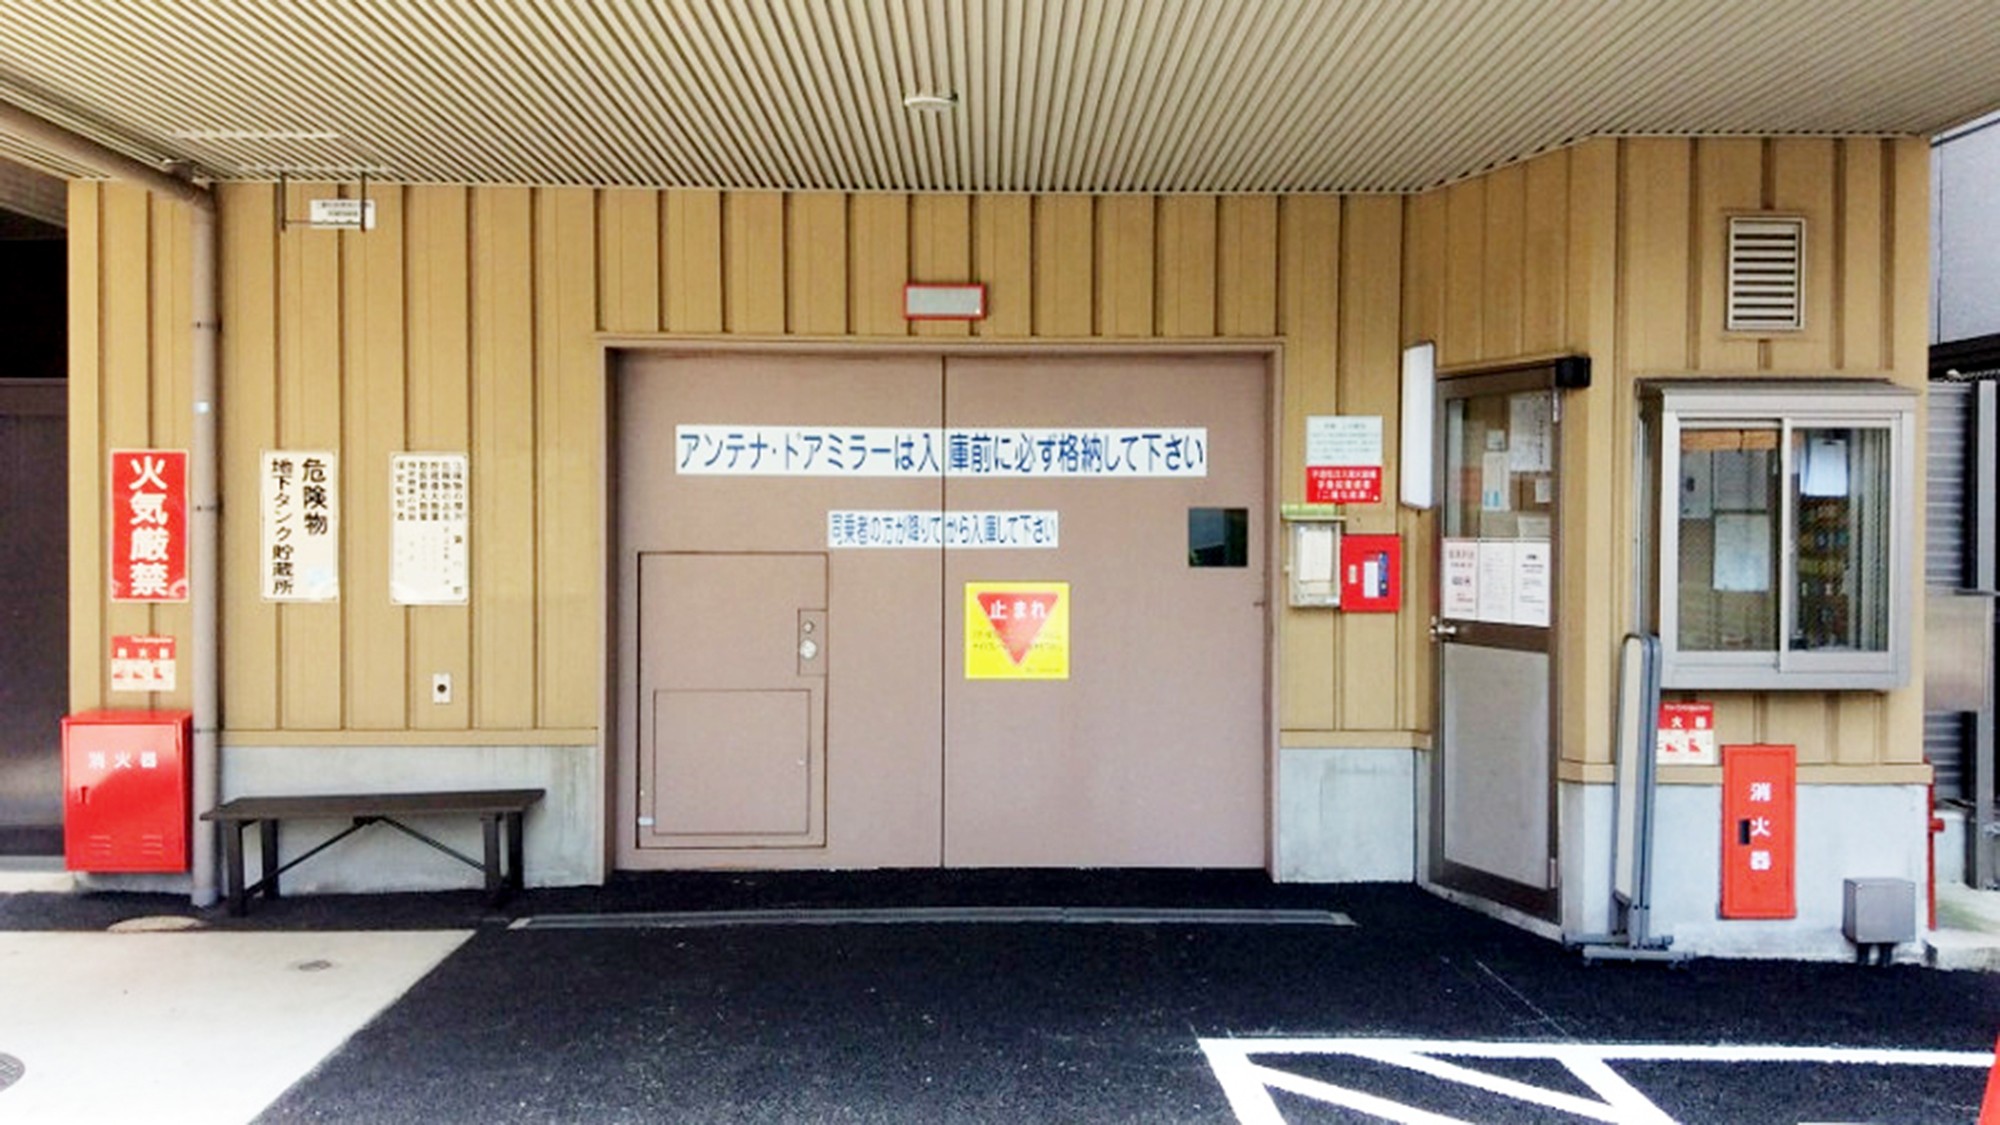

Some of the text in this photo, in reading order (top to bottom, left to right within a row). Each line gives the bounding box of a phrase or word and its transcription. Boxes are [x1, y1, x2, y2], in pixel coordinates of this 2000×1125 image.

[129, 456, 168, 596] 火気厳禁
[271, 458, 294, 595] 地下タンク貯蔵所
[302, 458, 328, 536] 危険物
[832, 514, 1056, 545] 同乗者の方が降りてから入庫して下さい
[990, 599, 1046, 620] 止まれ
[88, 751, 157, 769] 消火器
[1750, 781, 1770, 870] 消火器
